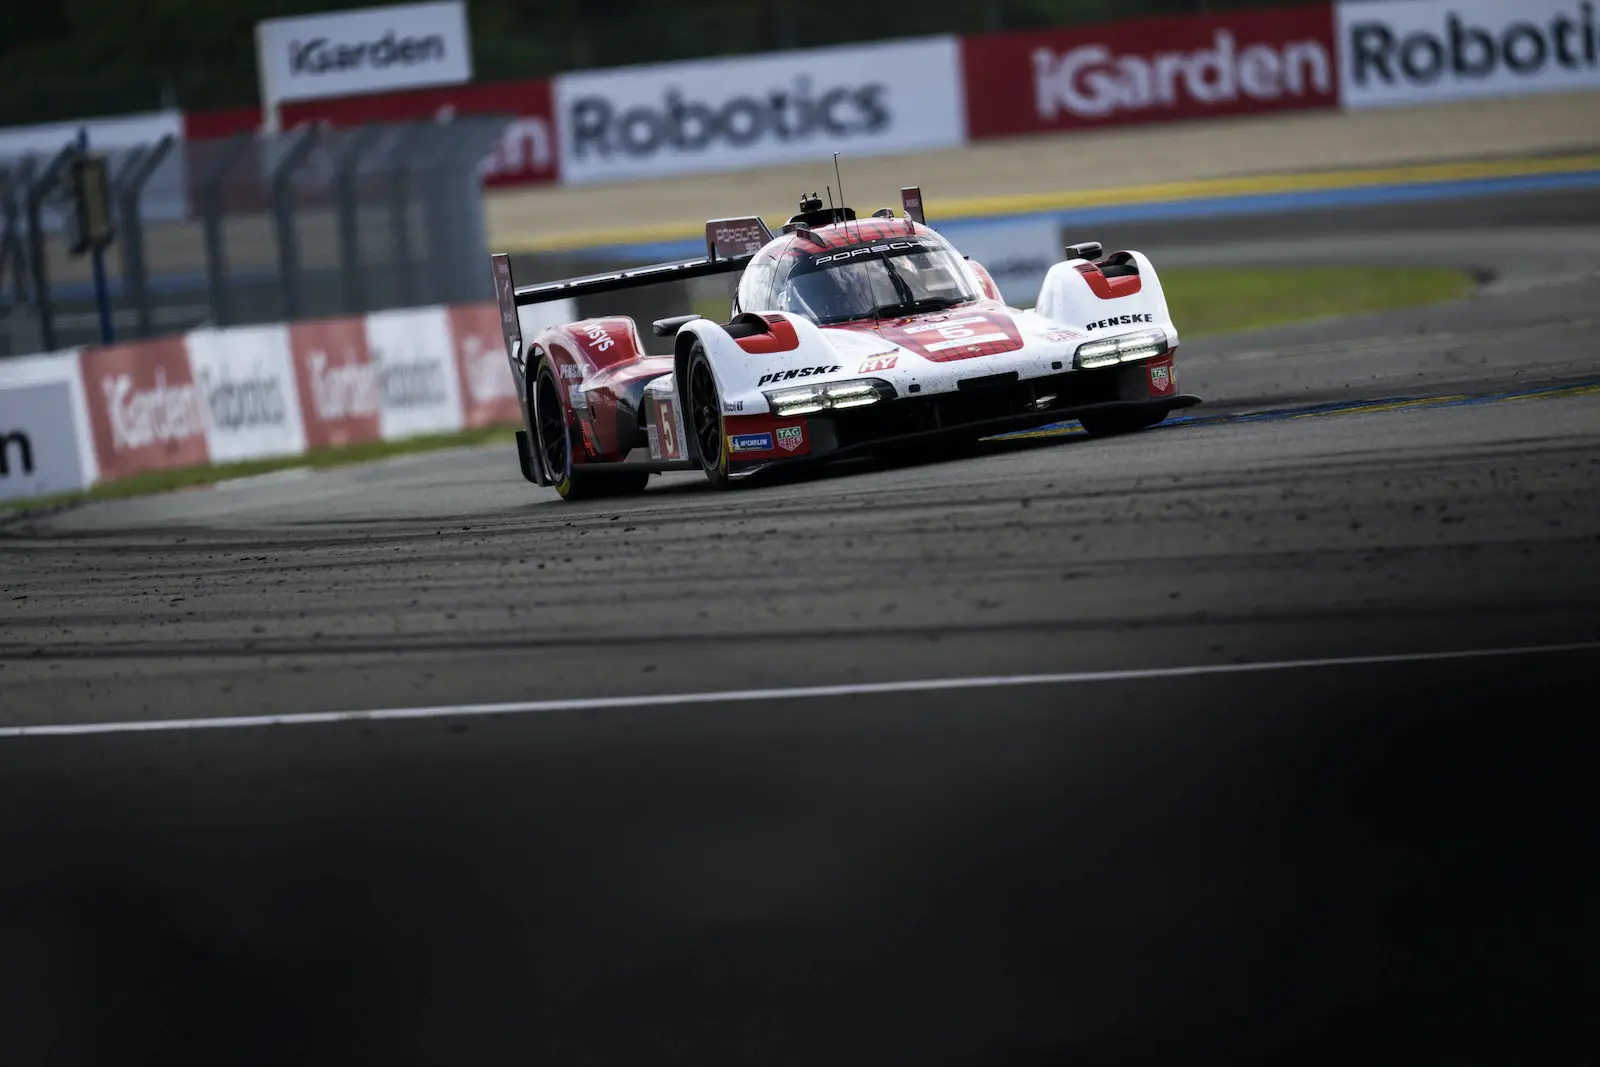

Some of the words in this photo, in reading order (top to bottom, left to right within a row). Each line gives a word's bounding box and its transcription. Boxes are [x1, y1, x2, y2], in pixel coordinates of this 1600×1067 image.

[288, 29, 446, 77] iGarden
[1031, 28, 1334, 121] iGarden
[570, 73, 894, 163] Robotics
[715, 225, 760, 243] PORSCHE
[815, 239, 940, 266] PORSCHE
[1086, 313, 1153, 331] PENSKE
[937, 325, 975, 339] 5
[860, 357, 896, 373] HY
[1152, 368, 1168, 378] TAG
[757, 365, 844, 387] PENSKE
[660, 403, 674, 454] 5
[778, 428, 800, 438] TAG
[740, 439, 768, 447] MICHELIN
[779, 436, 802, 449] HEUER
